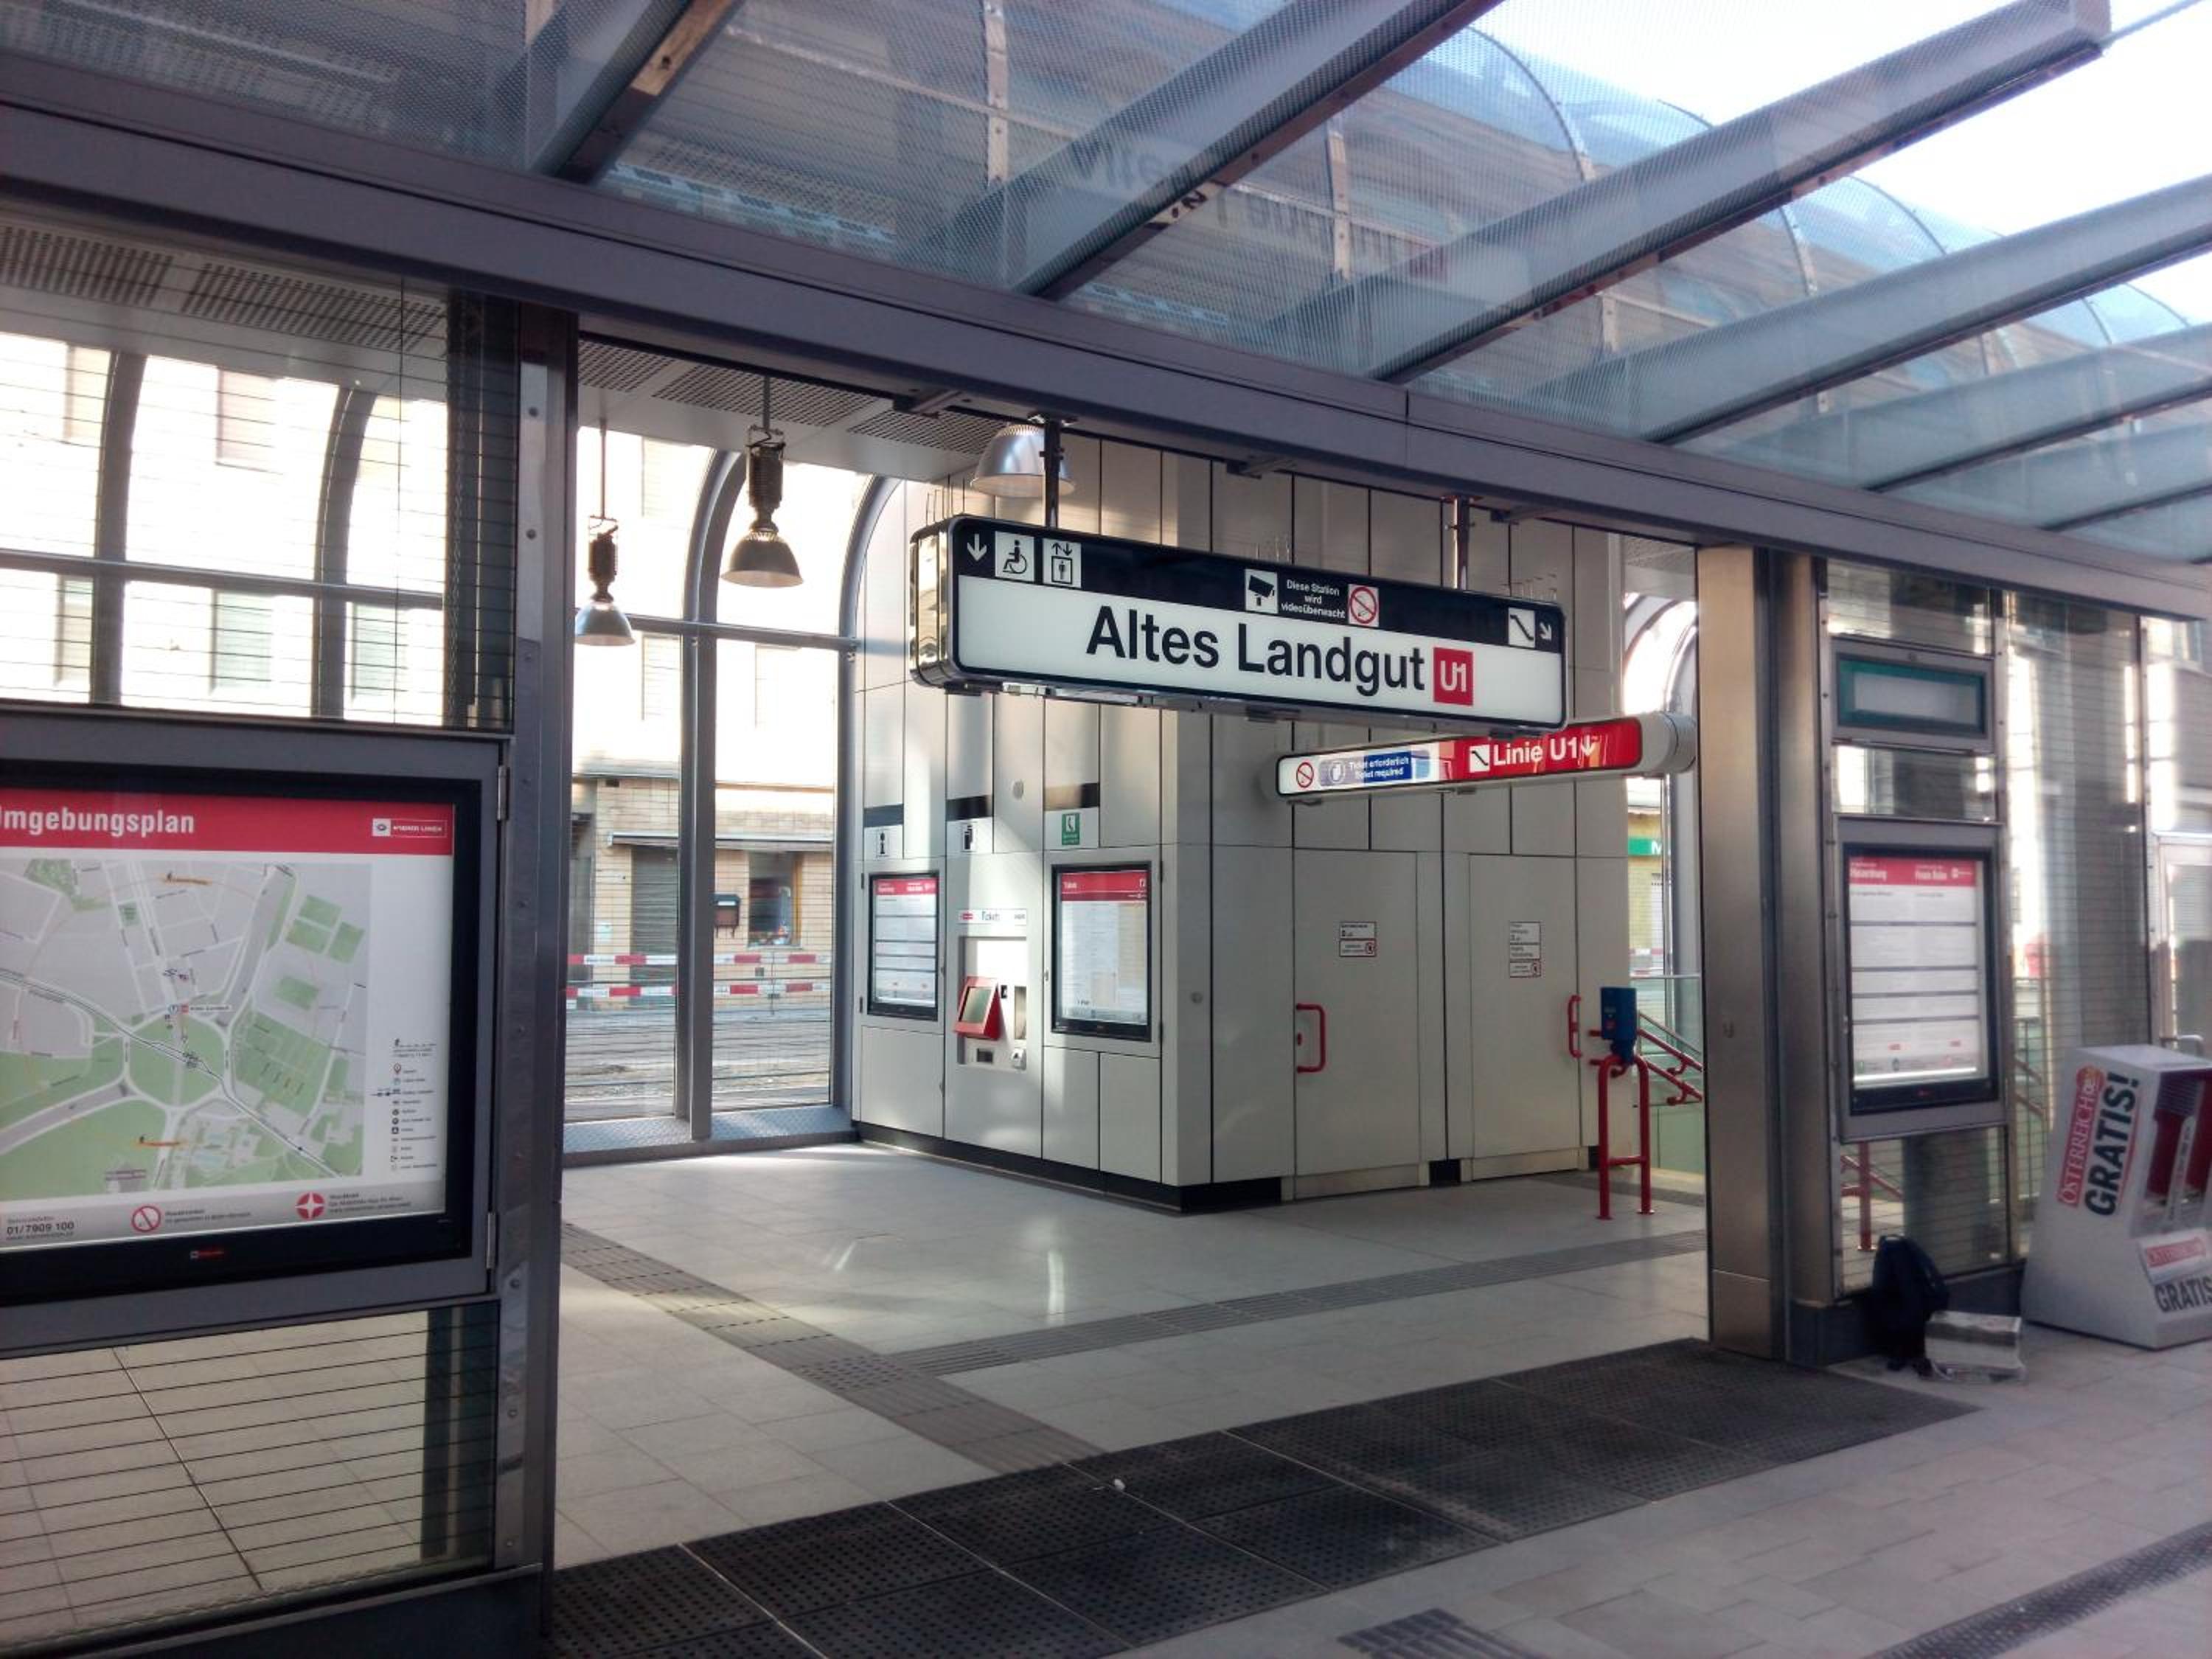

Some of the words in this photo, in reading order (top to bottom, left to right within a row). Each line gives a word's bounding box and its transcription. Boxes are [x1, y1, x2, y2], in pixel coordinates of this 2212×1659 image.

[1286, 579, 1310, 592] Diese
[1311, 582, 1340, 597] Station
[1304, 594, 1322, 605] wird
[1281, 601, 1346, 619] videoüberwacht
[1085, 605, 1220, 668] Altes
[1237, 622, 1426, 697] Landgut
[1493, 741, 1544, 766] Linie
[1550, 737, 1578, 761] U1
[2084, 1071, 2140, 1217] GRATIS!
